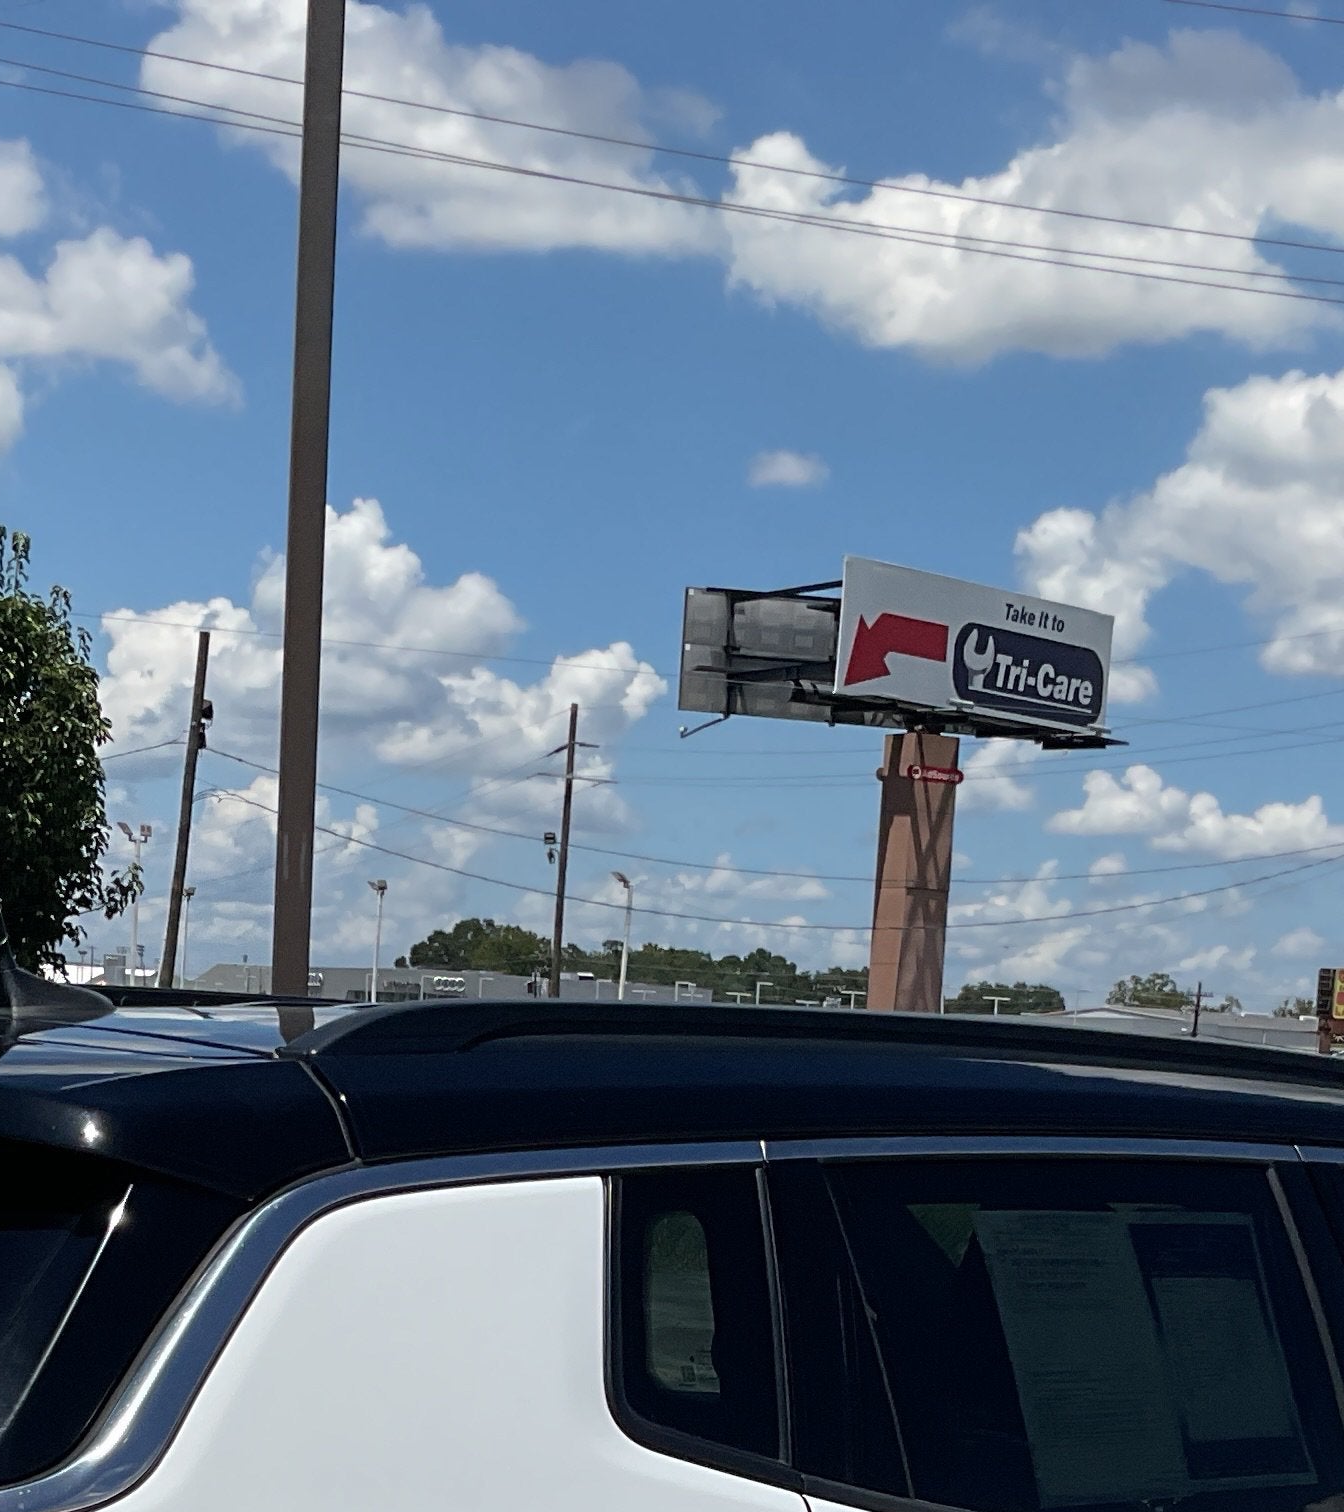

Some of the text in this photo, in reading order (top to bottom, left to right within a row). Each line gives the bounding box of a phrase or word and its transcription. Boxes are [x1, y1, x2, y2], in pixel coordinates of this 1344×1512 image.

[1005, 603, 1036, 626] Take
[1051, 614, 1065, 633] to
[996, 653, 1094, 705] Tri-Care
